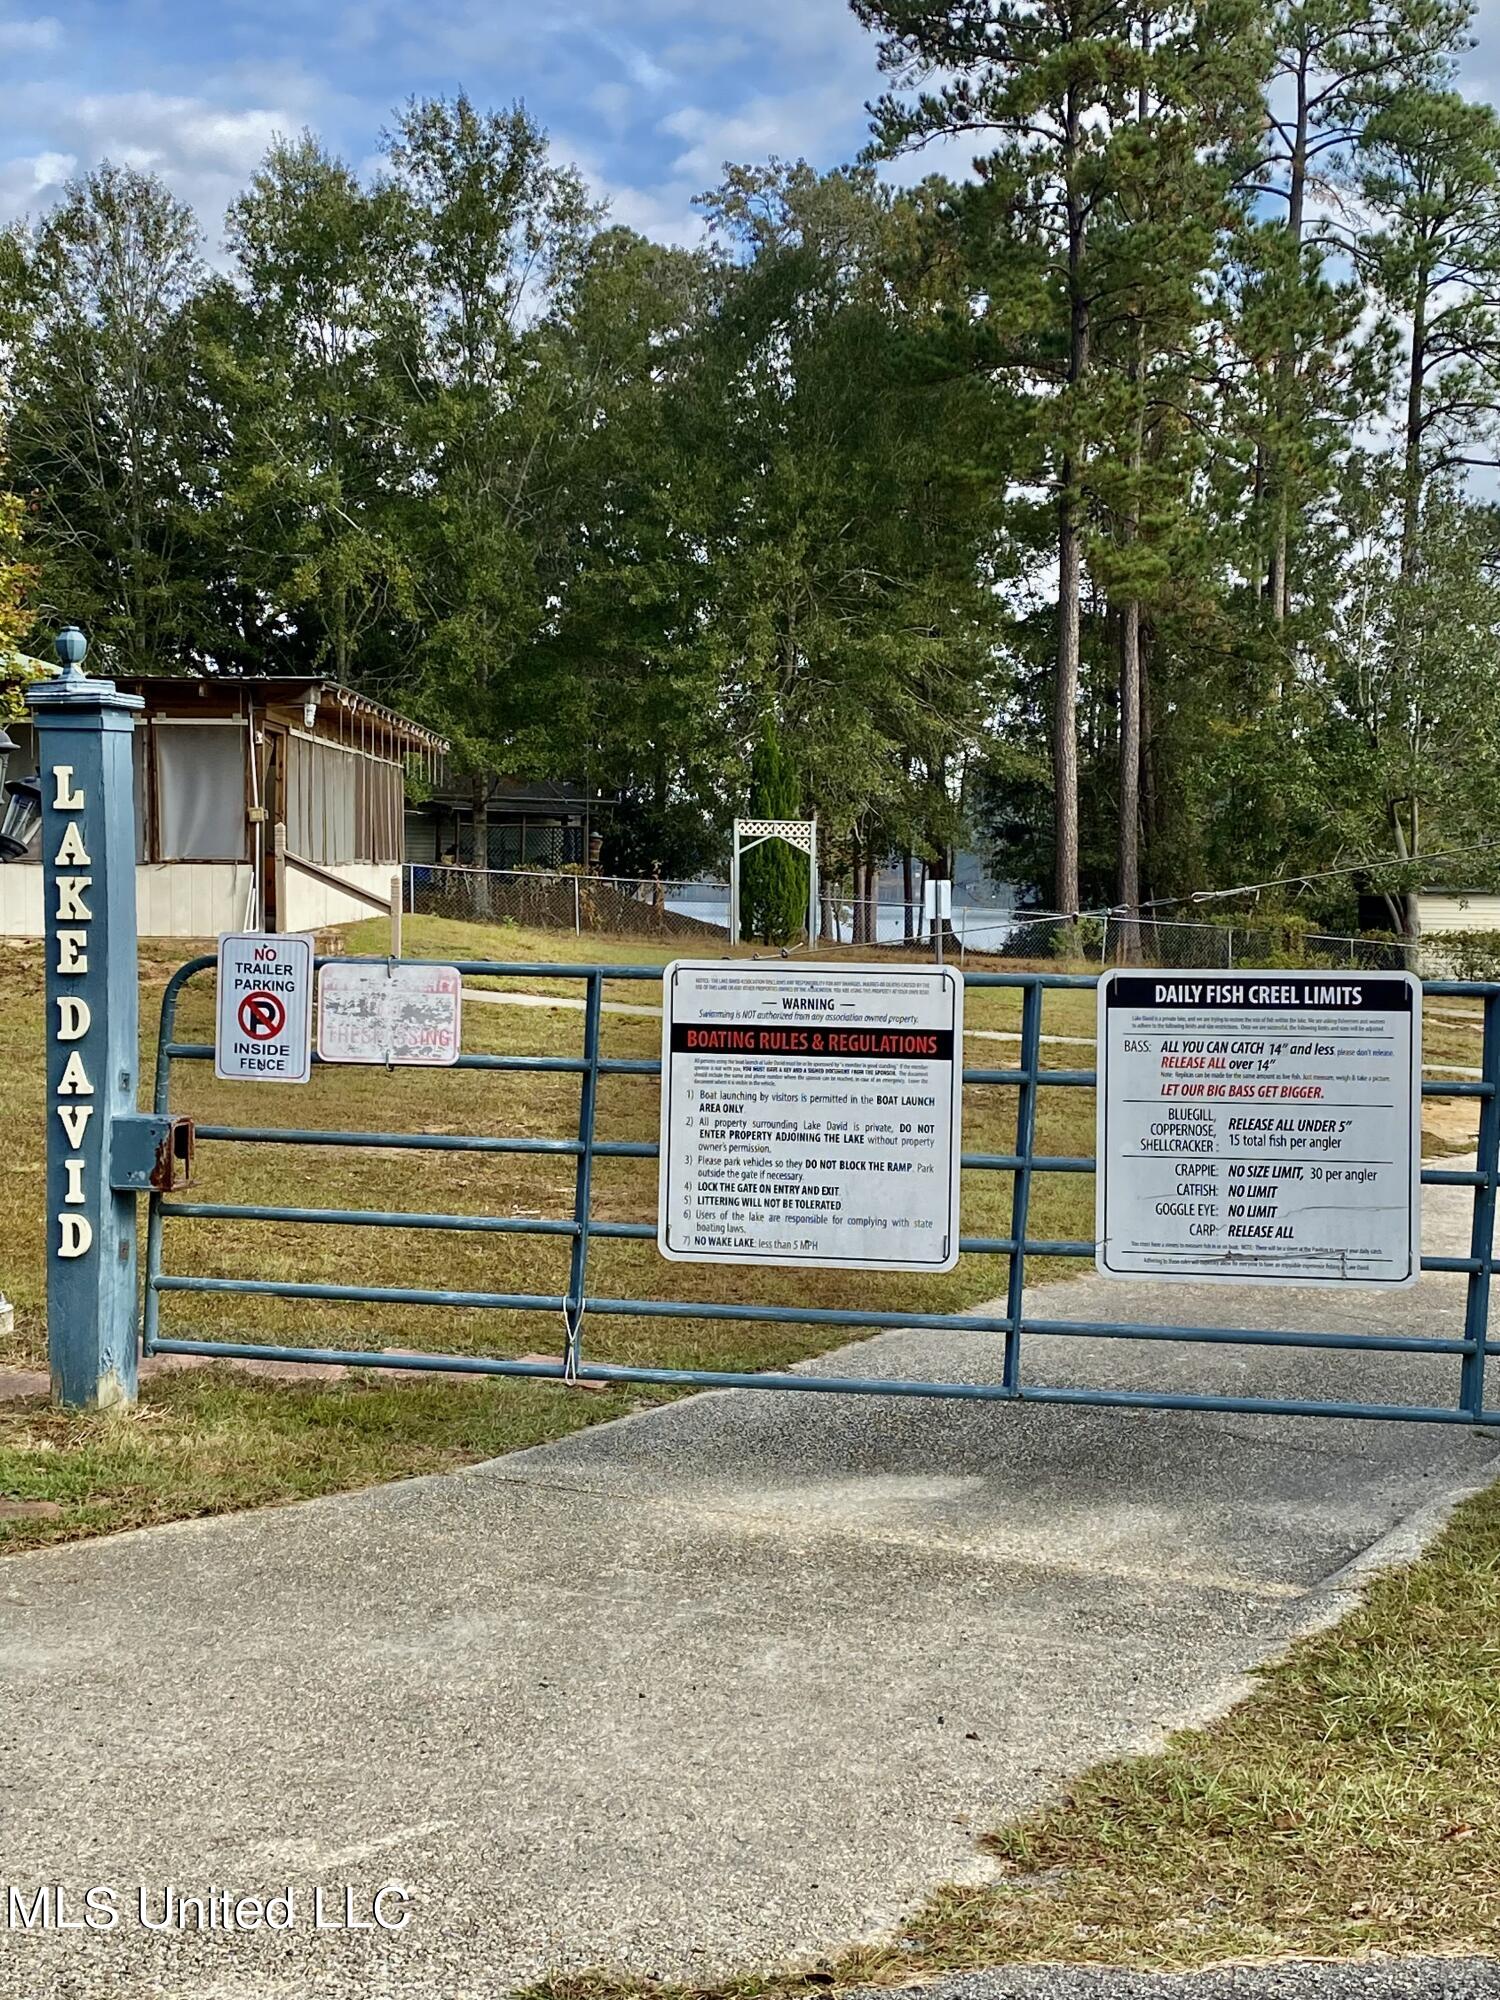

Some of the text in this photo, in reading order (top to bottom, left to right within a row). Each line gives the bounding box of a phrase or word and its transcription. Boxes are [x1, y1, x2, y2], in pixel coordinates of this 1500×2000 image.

[255, 949, 276, 961] NO
[235, 962, 292, 976] TRAILER
[235, 979, 294, 992] PARKING
[1156, 986, 1362, 1004] DAILY FISH CREEL LIMITS
[782, 998, 834, 1010] WARNING
[53, 766, 94, 1258] LAKE DAVID
[688, 1031, 937, 1053] BOATING RULES & REGULATIONS
[1125, 1040, 1151, 1052] BASS:
[1161, 1041, 1179, 1052] ALL
[1183, 1041, 1204, 1053] YOU
[1207, 1042, 1229, 1053] CAN
[1231, 1042, 1264, 1054] CATCH
[1290, 1042, 1312, 1055] and
[234, 1043, 290, 1056] INSIDE
[241, 1058, 284, 1070] FENCE
[1161, 1056, 1206, 1068] RELEASE
[1207, 1057, 1226, 1069] ALL
[1229, 1060, 1254, 1070] over
[687, 1090, 935, 1106] 1) Boat launching by visitors is permitted in the BOAT LAUNCH
[1161, 1084, 1324, 1098] LET OUR BIG BASS GET BIGGER.
[700, 1104, 721, 1112] AREA
[1169, 1108, 1216, 1122] BLUEGILL,
[686, 1117, 693, 1127] 2)
[699, 1117, 709, 1126] All
[715, 1119, 747, 1129] property
[753, 1119, 798, 1131] surrounding
[804, 1121, 821, 1130] Lake
[827, 1121, 848, 1131] David
[900, 1124, 911, 1133] DO
[918, 1124, 935, 1134] NOT
[1151, 1123, 1216, 1138] COPPERNOSE,
[1228, 1118, 1274, 1131] RELEASE
[1275, 1119, 1294, 1131] ALL
[1298, 1120, 1336, 1132] UNDER
[700, 1130, 934, 1147] ENTER PROPERTY ADJOINING THE LAKE without property
[1229, 1134, 1342, 1150] 15 total fish per angler
[698, 1143, 727, 1151] owner's
[686, 1156, 692, 1165] 3)
[698, 1156, 721, 1165] Please
[724, 1158, 740, 1167] park
[743, 1157, 773, 1167] vehicles
[786, 1159, 802, 1170] they
[806, 1159, 817, 1169] DO
[820, 1160, 837, 1169] NOT
[840, 1160, 866, 1170] BLOCK
[868, 1162, 884, 1171] THE
[918, 1164, 933, 1172] Park
[698, 1169, 804, 1182] outside the gate if necessary.
[1175, 1163, 1378, 1183] CRAPPIE: NO SIZE LIMIT, 30 per angler
[685, 1182, 692, 1190] 4)
[698, 1183, 718, 1191] LOCK
[720, 1183, 735, 1192] THE
[738, 1184, 757, 1193] GATE
[759, 1184, 771, 1193] ON
[774, 1185, 800, 1194] ENTRY
[802, 1186, 820, 1195] AND
[1177, 1184, 1278, 1198] CATFISH: NO LIMIT
[684, 1196, 691, 1204] 5)
[698, 1196, 740, 1206] LITTERING
[742, 1198, 762, 1207] WILL
[764, 1198, 780, 1208] NOT
[783, 1199, 793, 1208] BE
[1156, 1203, 1278, 1218] GOGGLE EYE: NO LIMIT
[684, 1210, 691, 1220] 6)
[696, 1210, 716, 1220] Users
[720, 1211, 728, 1220] of
[732, 1211, 744, 1221] the
[749, 1212, 764, 1222] lake
[785, 1213, 828, 1226] responsible
[832, 1215, 843, 1224] for
[847, 1216, 887, 1228] complying
[892, 1217, 909, 1227] with
[915, 1220, 933, 1228] state
[697, 1223, 746, 1235] boating laws.
[1228, 1225, 1274, 1238] RELEASE
[1275, 1226, 1294, 1238] ALL
[684, 1236, 690, 1245] 7)
[695, 1236, 706, 1245] NO
[708, 1237, 732, 1246] WAKE
[759, 1240, 772, 1248] less
[774, 1240, 791, 1249] than
[794, 1241, 798, 1249] 5
[800, 1240, 818, 1250] MPH
